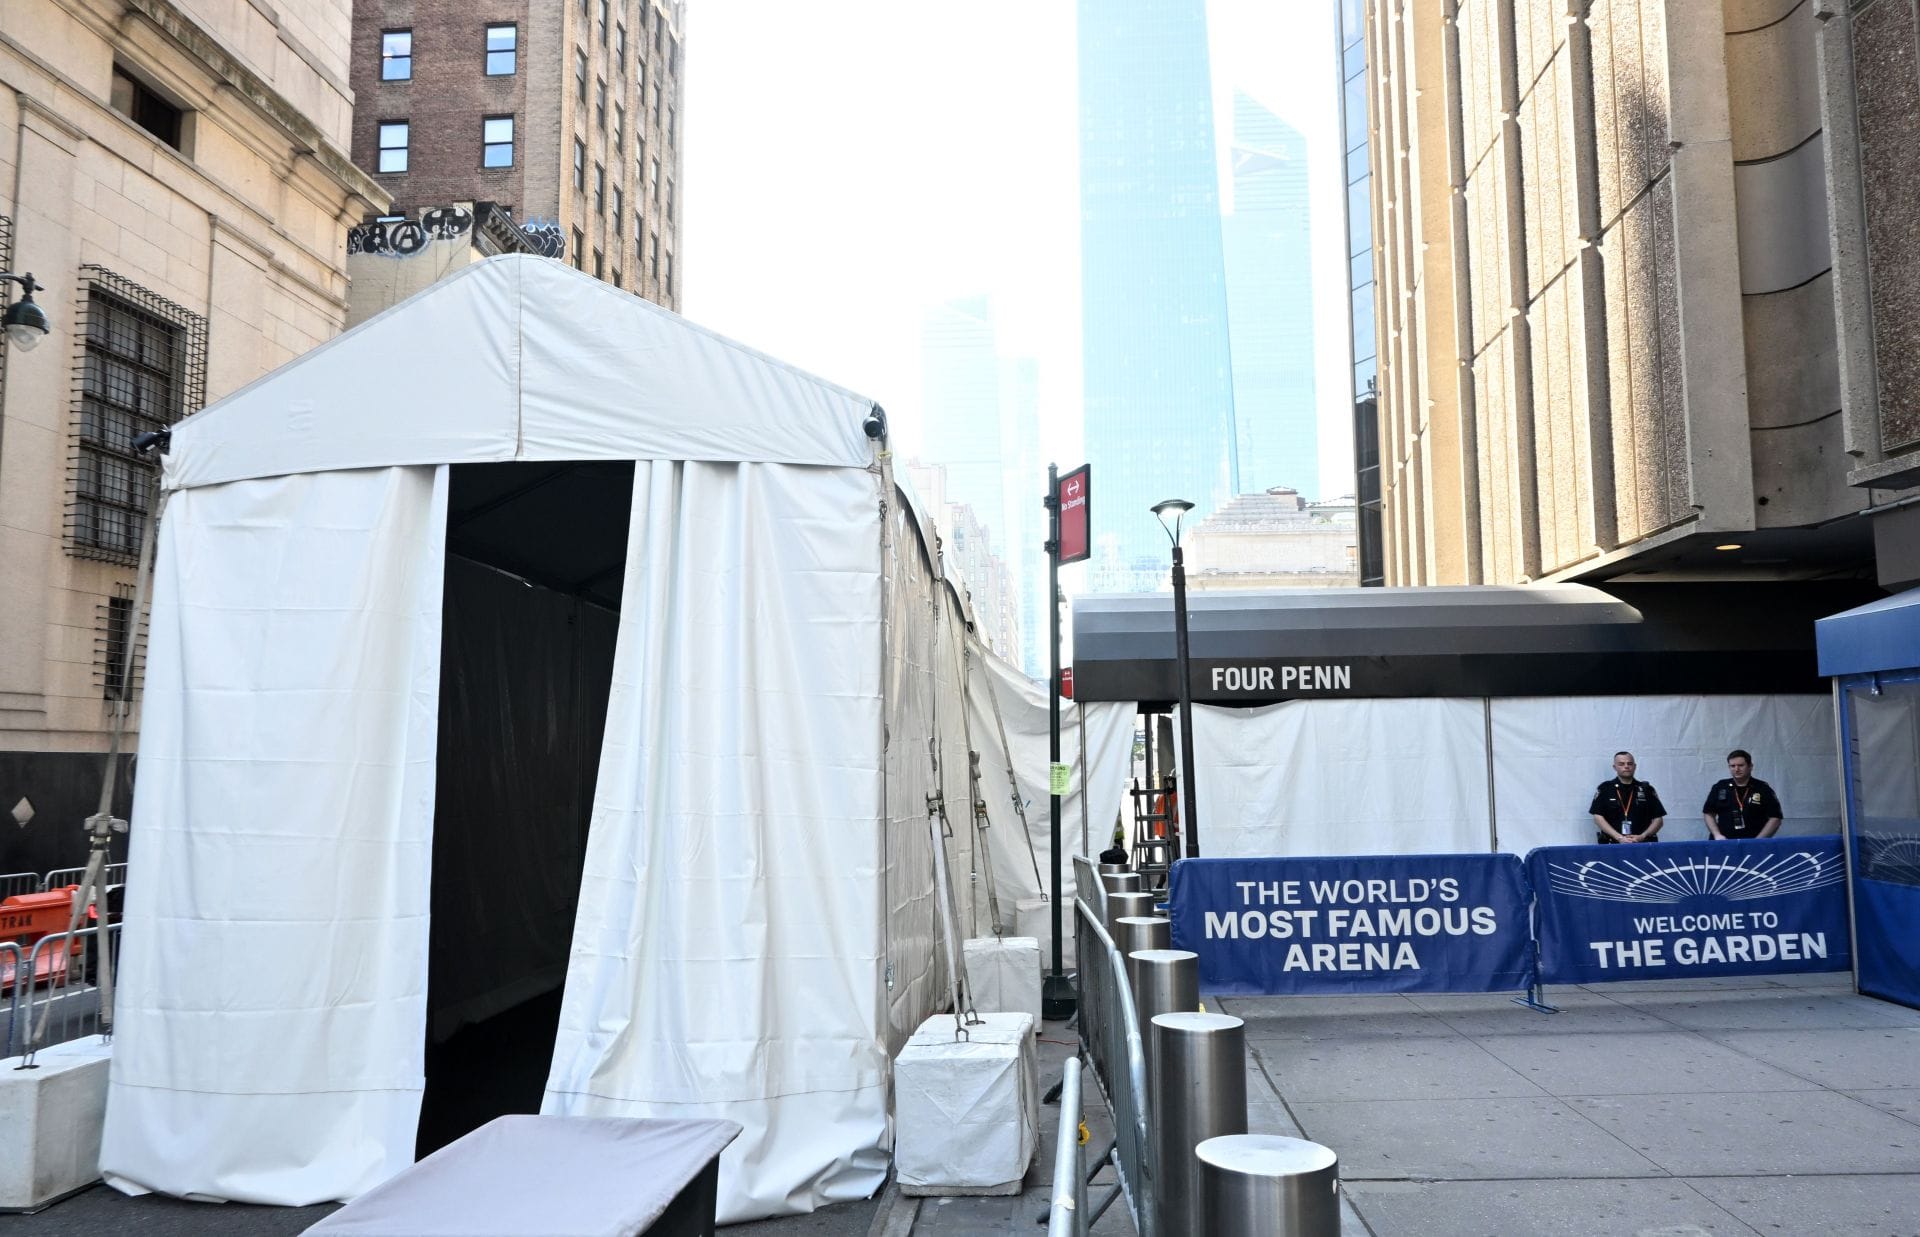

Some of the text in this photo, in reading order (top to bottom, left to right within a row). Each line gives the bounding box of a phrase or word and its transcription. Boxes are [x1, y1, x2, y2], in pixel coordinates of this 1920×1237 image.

[1068, 496, 1086, 509] Standing
[1212, 665, 1351, 691] FOUR PENN
[1236, 877, 1460, 905] THE WORLD’S
[1204, 906, 1497, 939] MOST FAMOUS
[1633, 911, 1779, 934] WELCOME TO
[1282, 942, 1421, 972] ARENA
[1589, 932, 1828, 969] THE GARDEN
